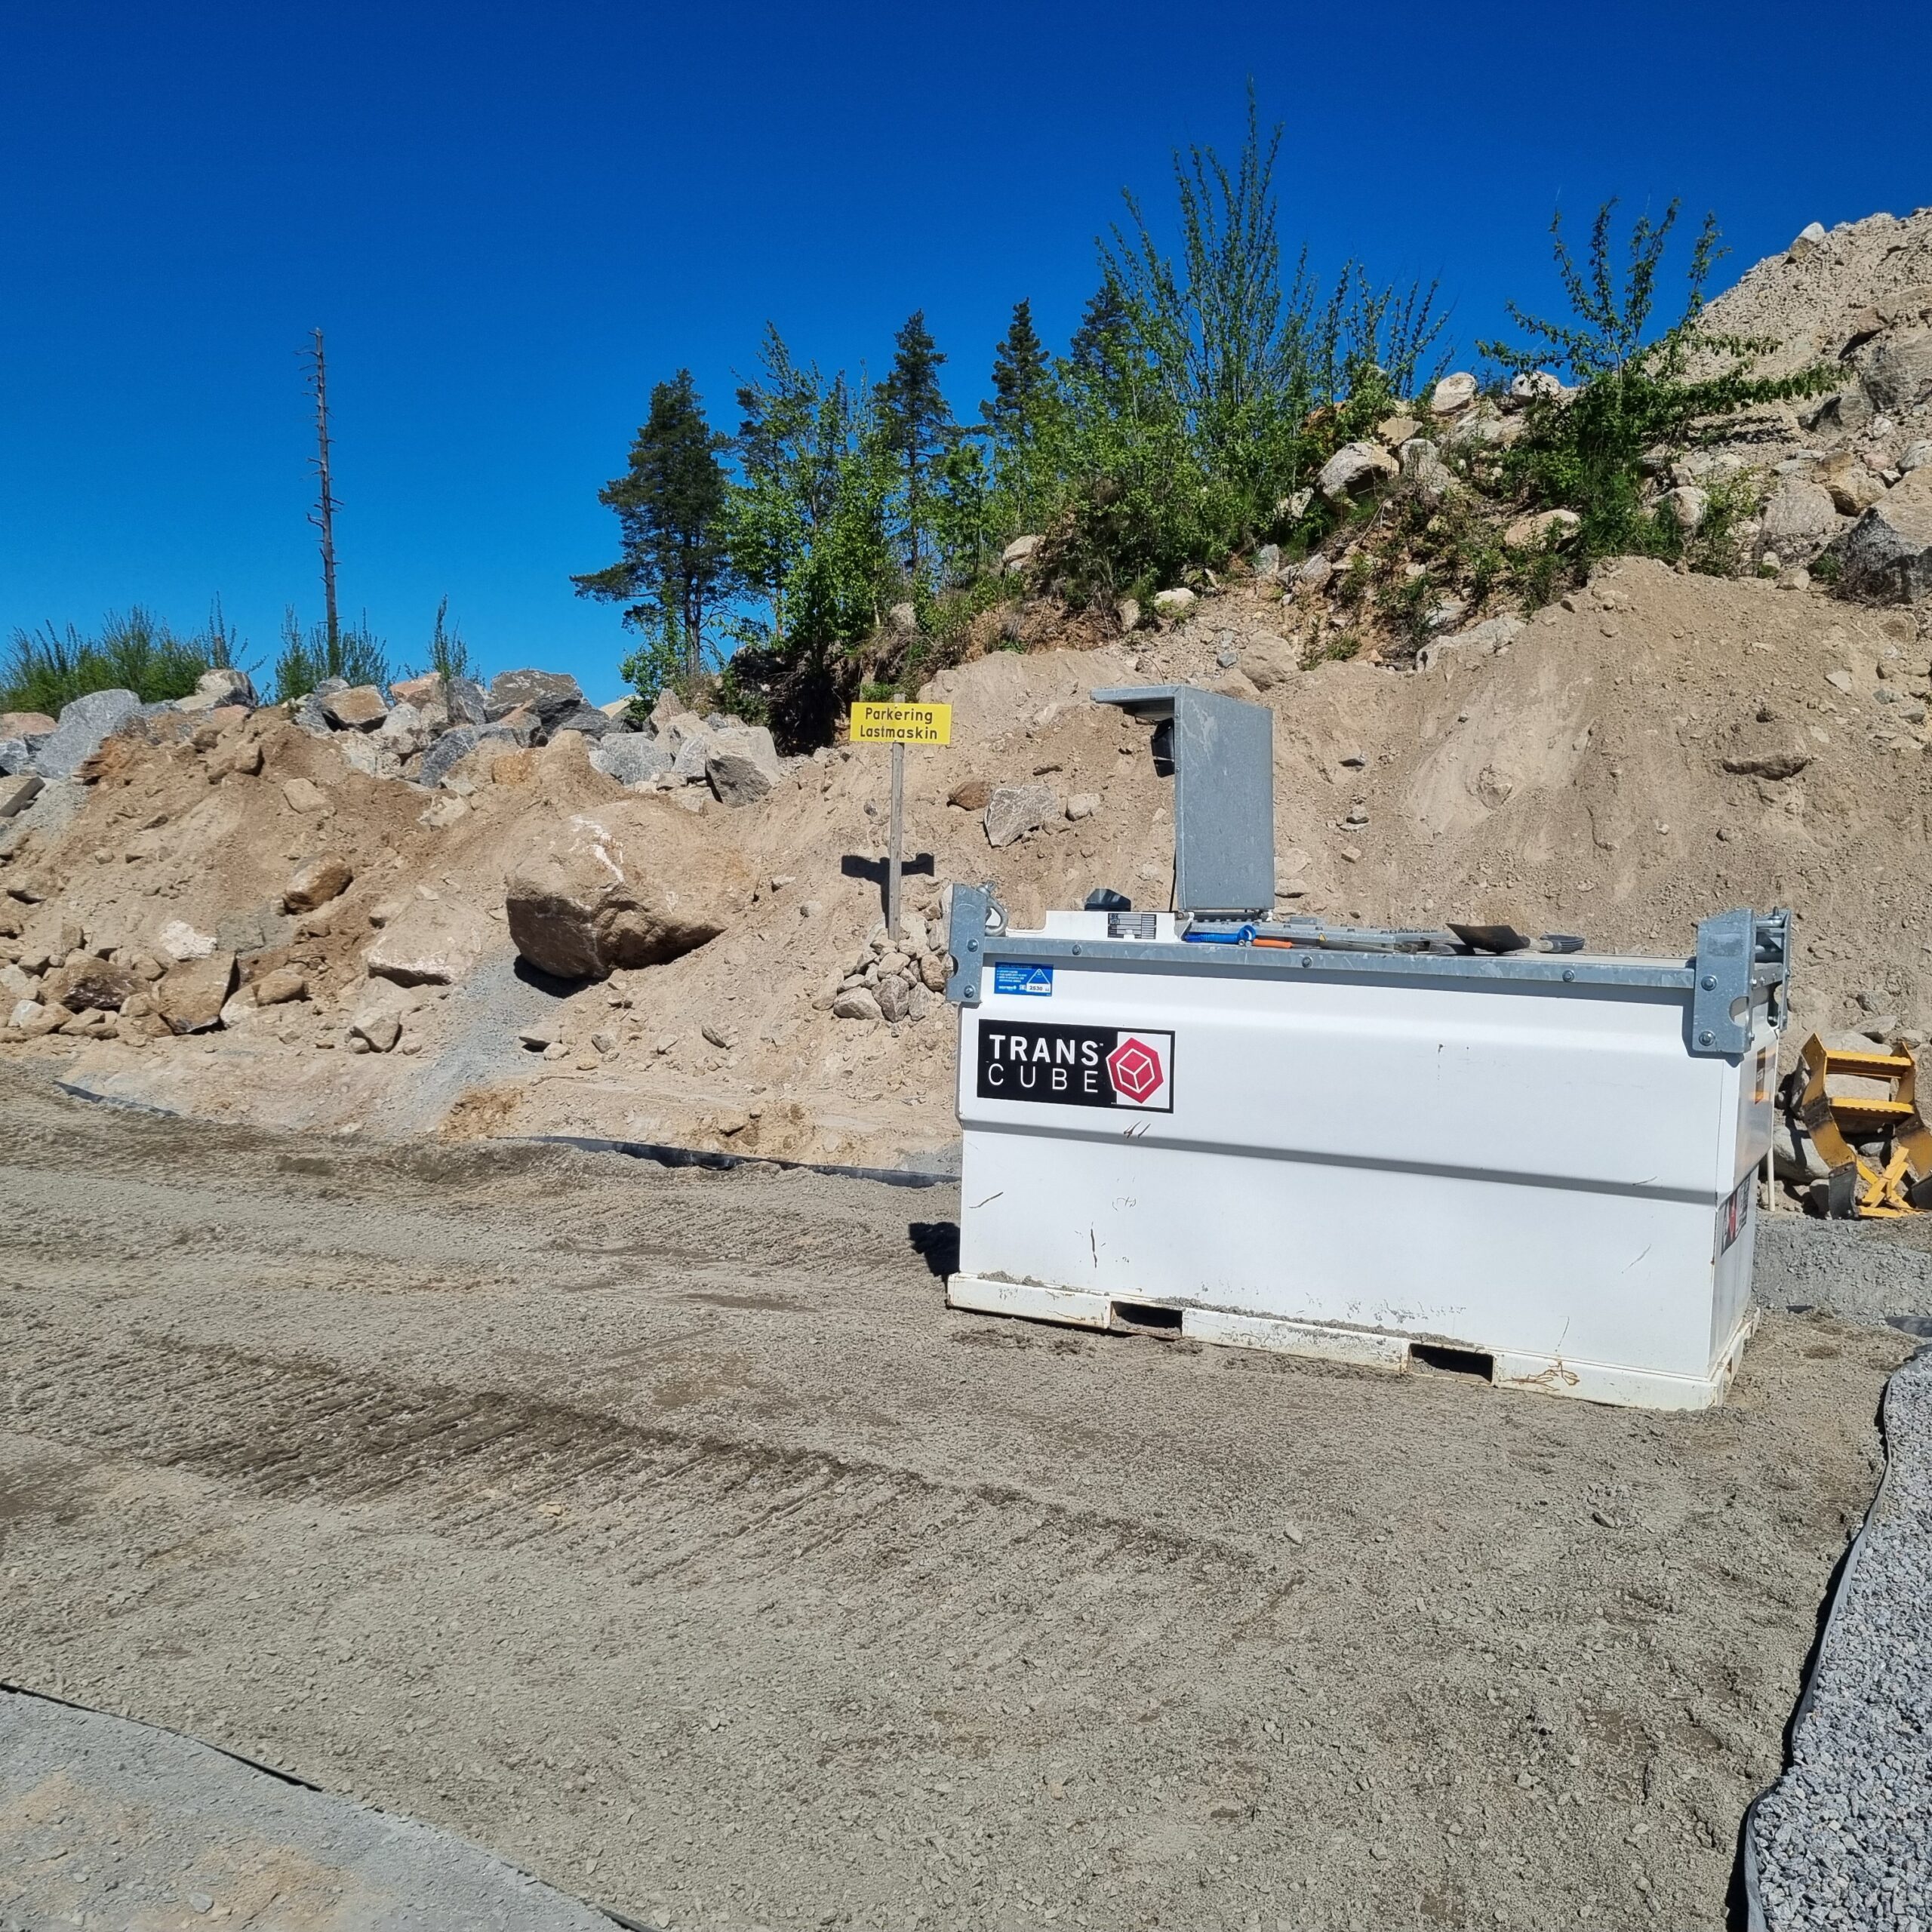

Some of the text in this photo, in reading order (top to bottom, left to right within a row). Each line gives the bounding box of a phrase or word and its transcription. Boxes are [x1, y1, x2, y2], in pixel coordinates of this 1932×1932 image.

[865, 707, 933, 724] Parkering
[860, 724, 937, 740] Lastmaskin
[989, 1034, 1099, 1066] TRANS
[988, 1063, 1099, 1093] CUBE
